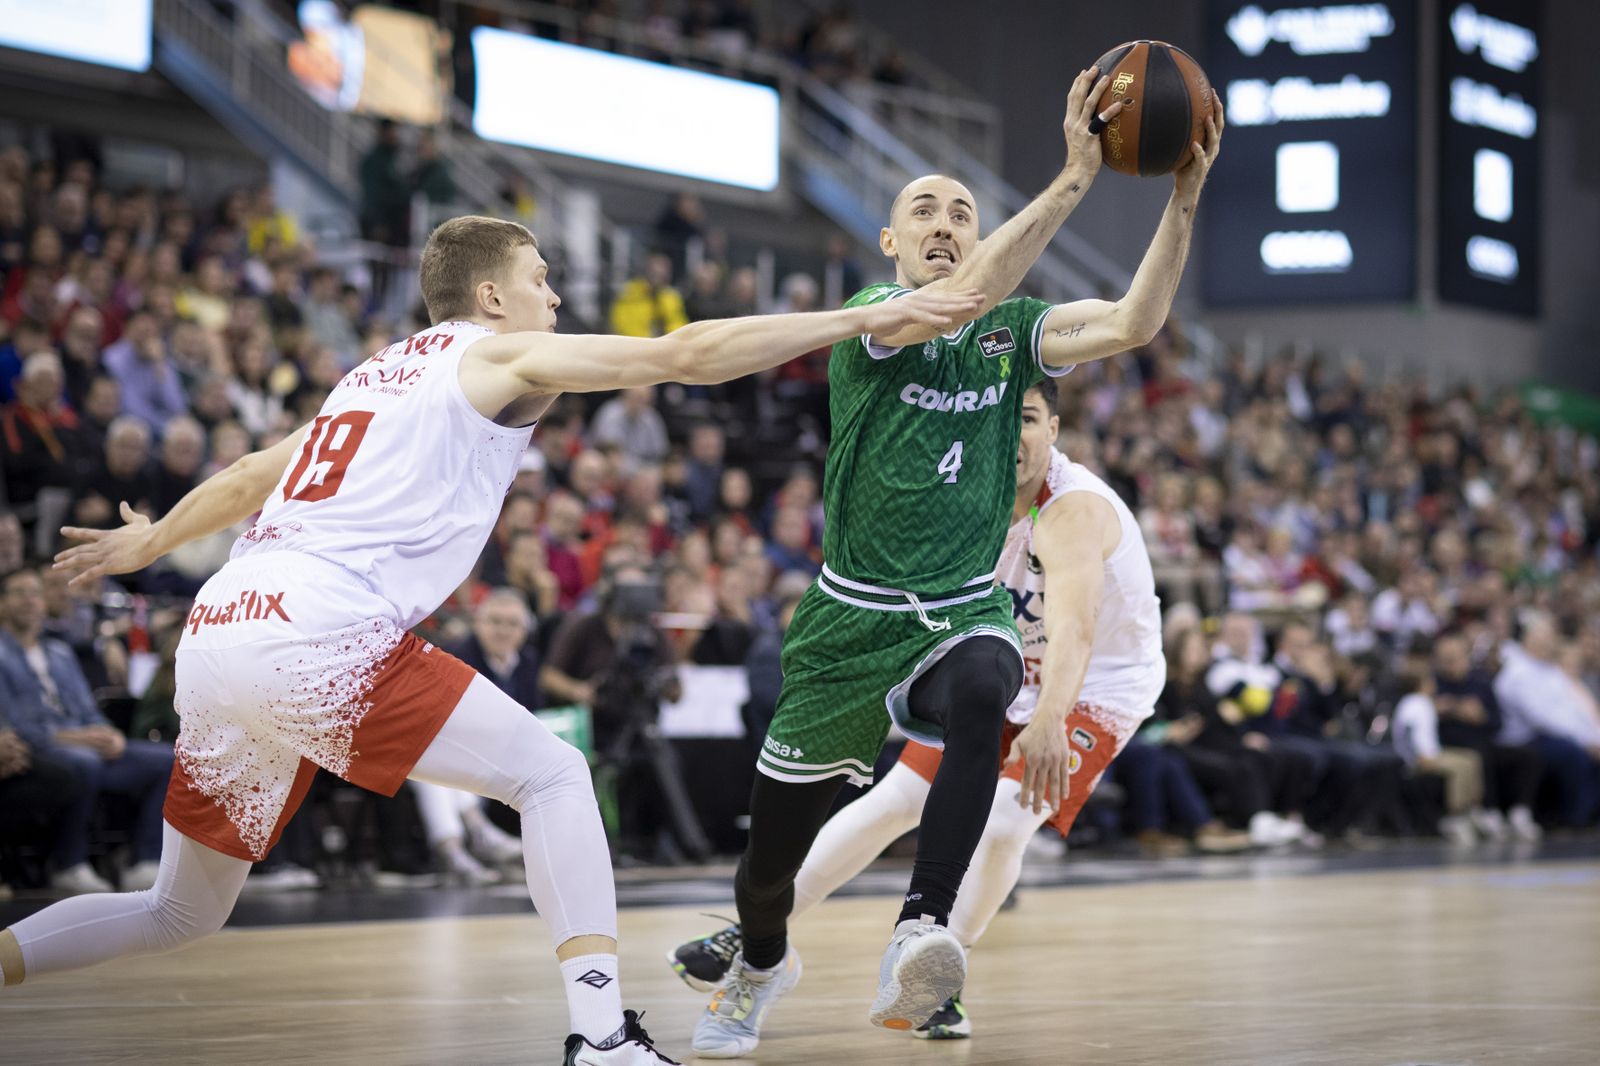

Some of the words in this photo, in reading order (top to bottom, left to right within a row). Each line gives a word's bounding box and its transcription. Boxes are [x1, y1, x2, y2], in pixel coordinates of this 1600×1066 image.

[982, 339, 997, 349] liga
[985, 341, 1013, 353] endesa
[283, 410, 376, 502] 19
[937, 440, 964, 484] 4
[184, 590, 292, 635] quaflix
[764, 735, 791, 757] sisa
